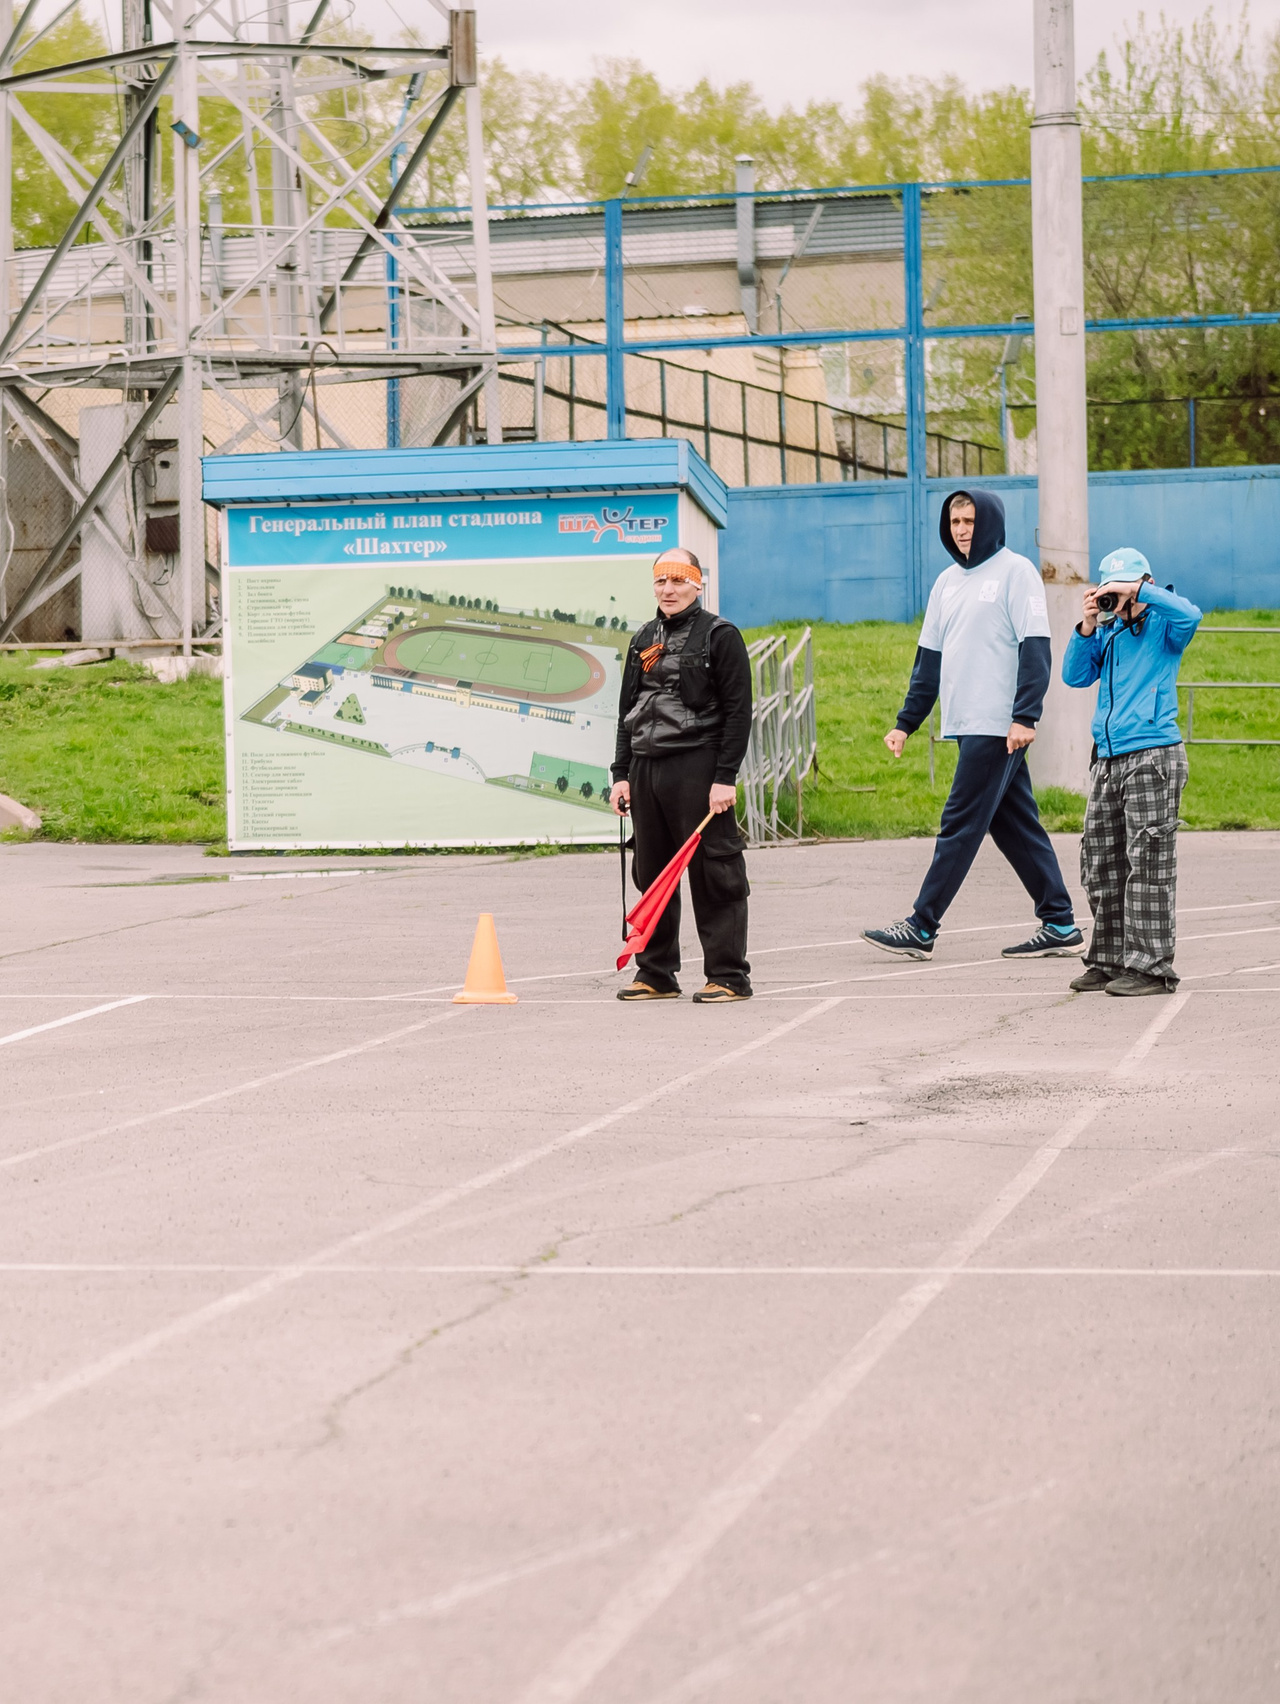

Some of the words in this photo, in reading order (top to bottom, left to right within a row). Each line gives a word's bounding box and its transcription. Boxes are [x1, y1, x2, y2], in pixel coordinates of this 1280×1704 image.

[249, 513, 386, 536] Генеральный
[393, 515, 442, 528] план
[448, 511, 542, 527] стадиона
[344, 537, 447, 557] «Шахтер»
